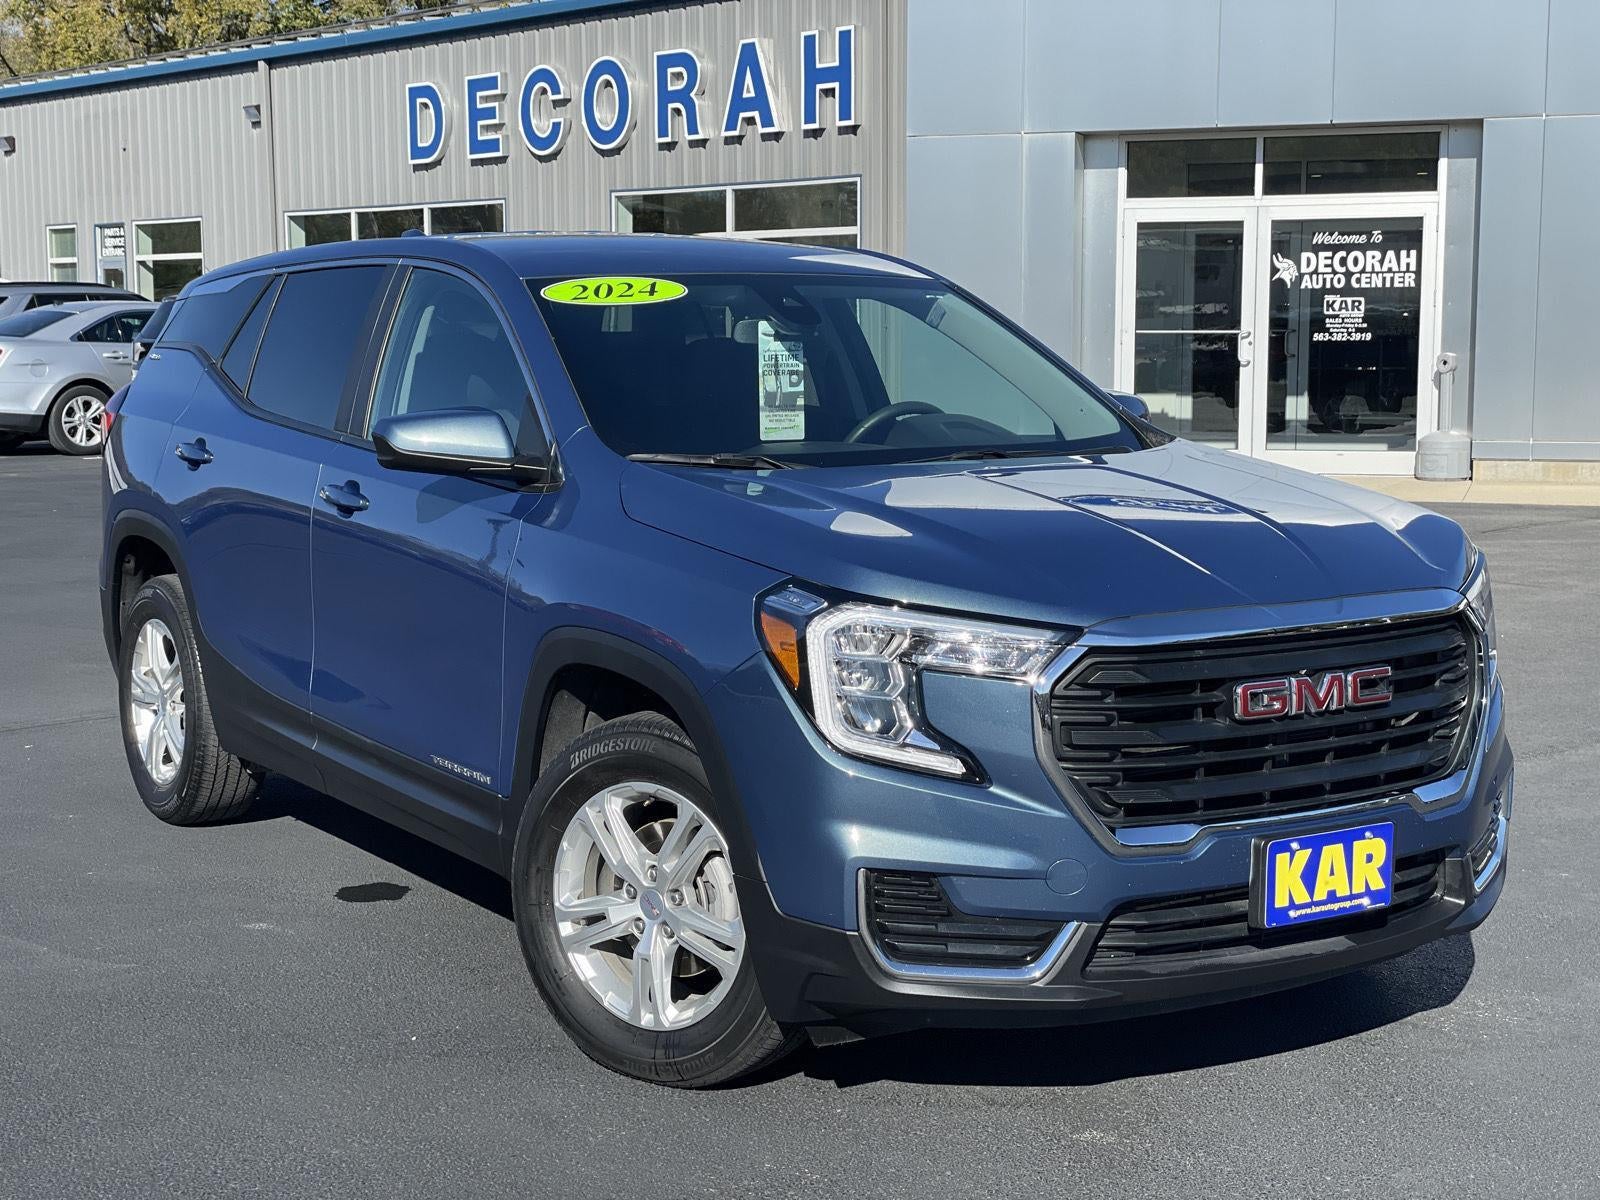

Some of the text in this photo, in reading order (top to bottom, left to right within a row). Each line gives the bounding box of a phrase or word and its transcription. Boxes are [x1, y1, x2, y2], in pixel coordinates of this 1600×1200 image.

[405, 24, 856, 165] DECORAH
[104, 227, 120, 236] PARTS
[1312, 230, 1383, 245] Welcome To
[104, 237, 125, 246] SERVICE
[1300, 249, 1417, 273] DECORAH
[1300, 272, 1416, 289] AUTO CENTER
[570, 281, 659, 301] 2024
[1325, 299, 1363, 312] KAR
[1312, 332, 1372, 341] 563-382-3919
[763, 353, 800, 362] LIFETIME
[1233, 666, 1393, 721] GMC
[569, 737, 659, 770] BRIDGESTONE
[1274, 837, 1387, 908] KAR
